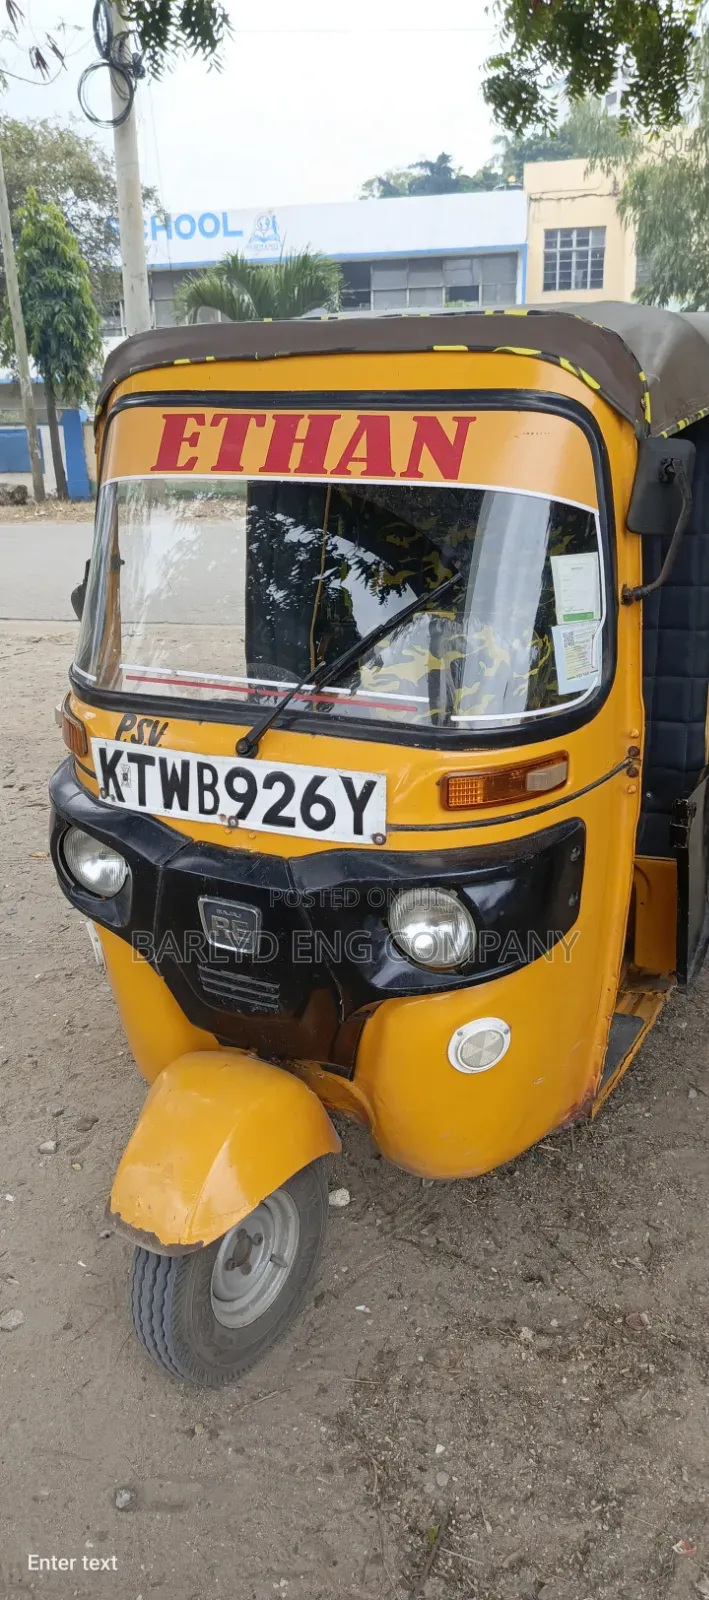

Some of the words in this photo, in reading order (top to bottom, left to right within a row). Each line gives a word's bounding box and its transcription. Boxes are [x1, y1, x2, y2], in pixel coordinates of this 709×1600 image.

[151, 413, 476, 480] ETHAN
[99, 747, 377, 836] KTWB926Y
[211, 914, 249, 943] RE
